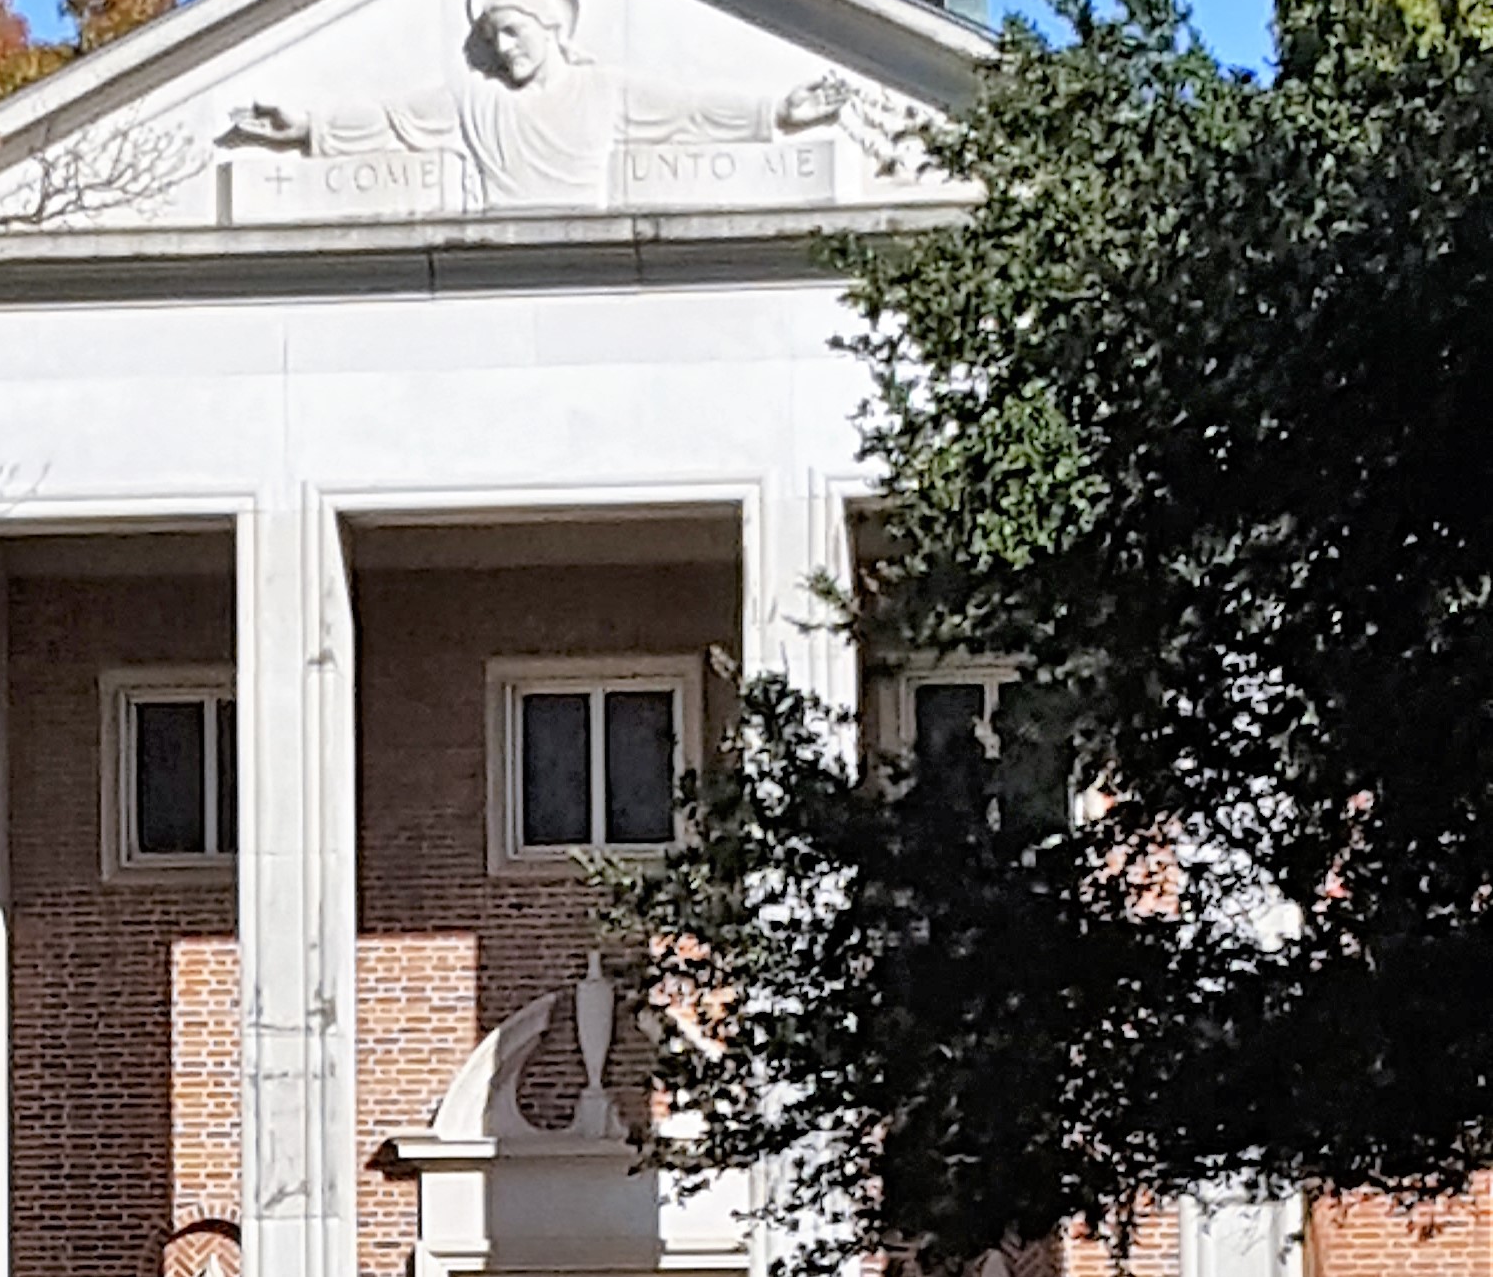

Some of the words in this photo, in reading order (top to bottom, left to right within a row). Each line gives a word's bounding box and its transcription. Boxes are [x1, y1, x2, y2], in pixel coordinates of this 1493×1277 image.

[325, 160, 439, 193] COME
[629, 151, 736, 181] UNTO
[762, 148, 815, 178] ME
